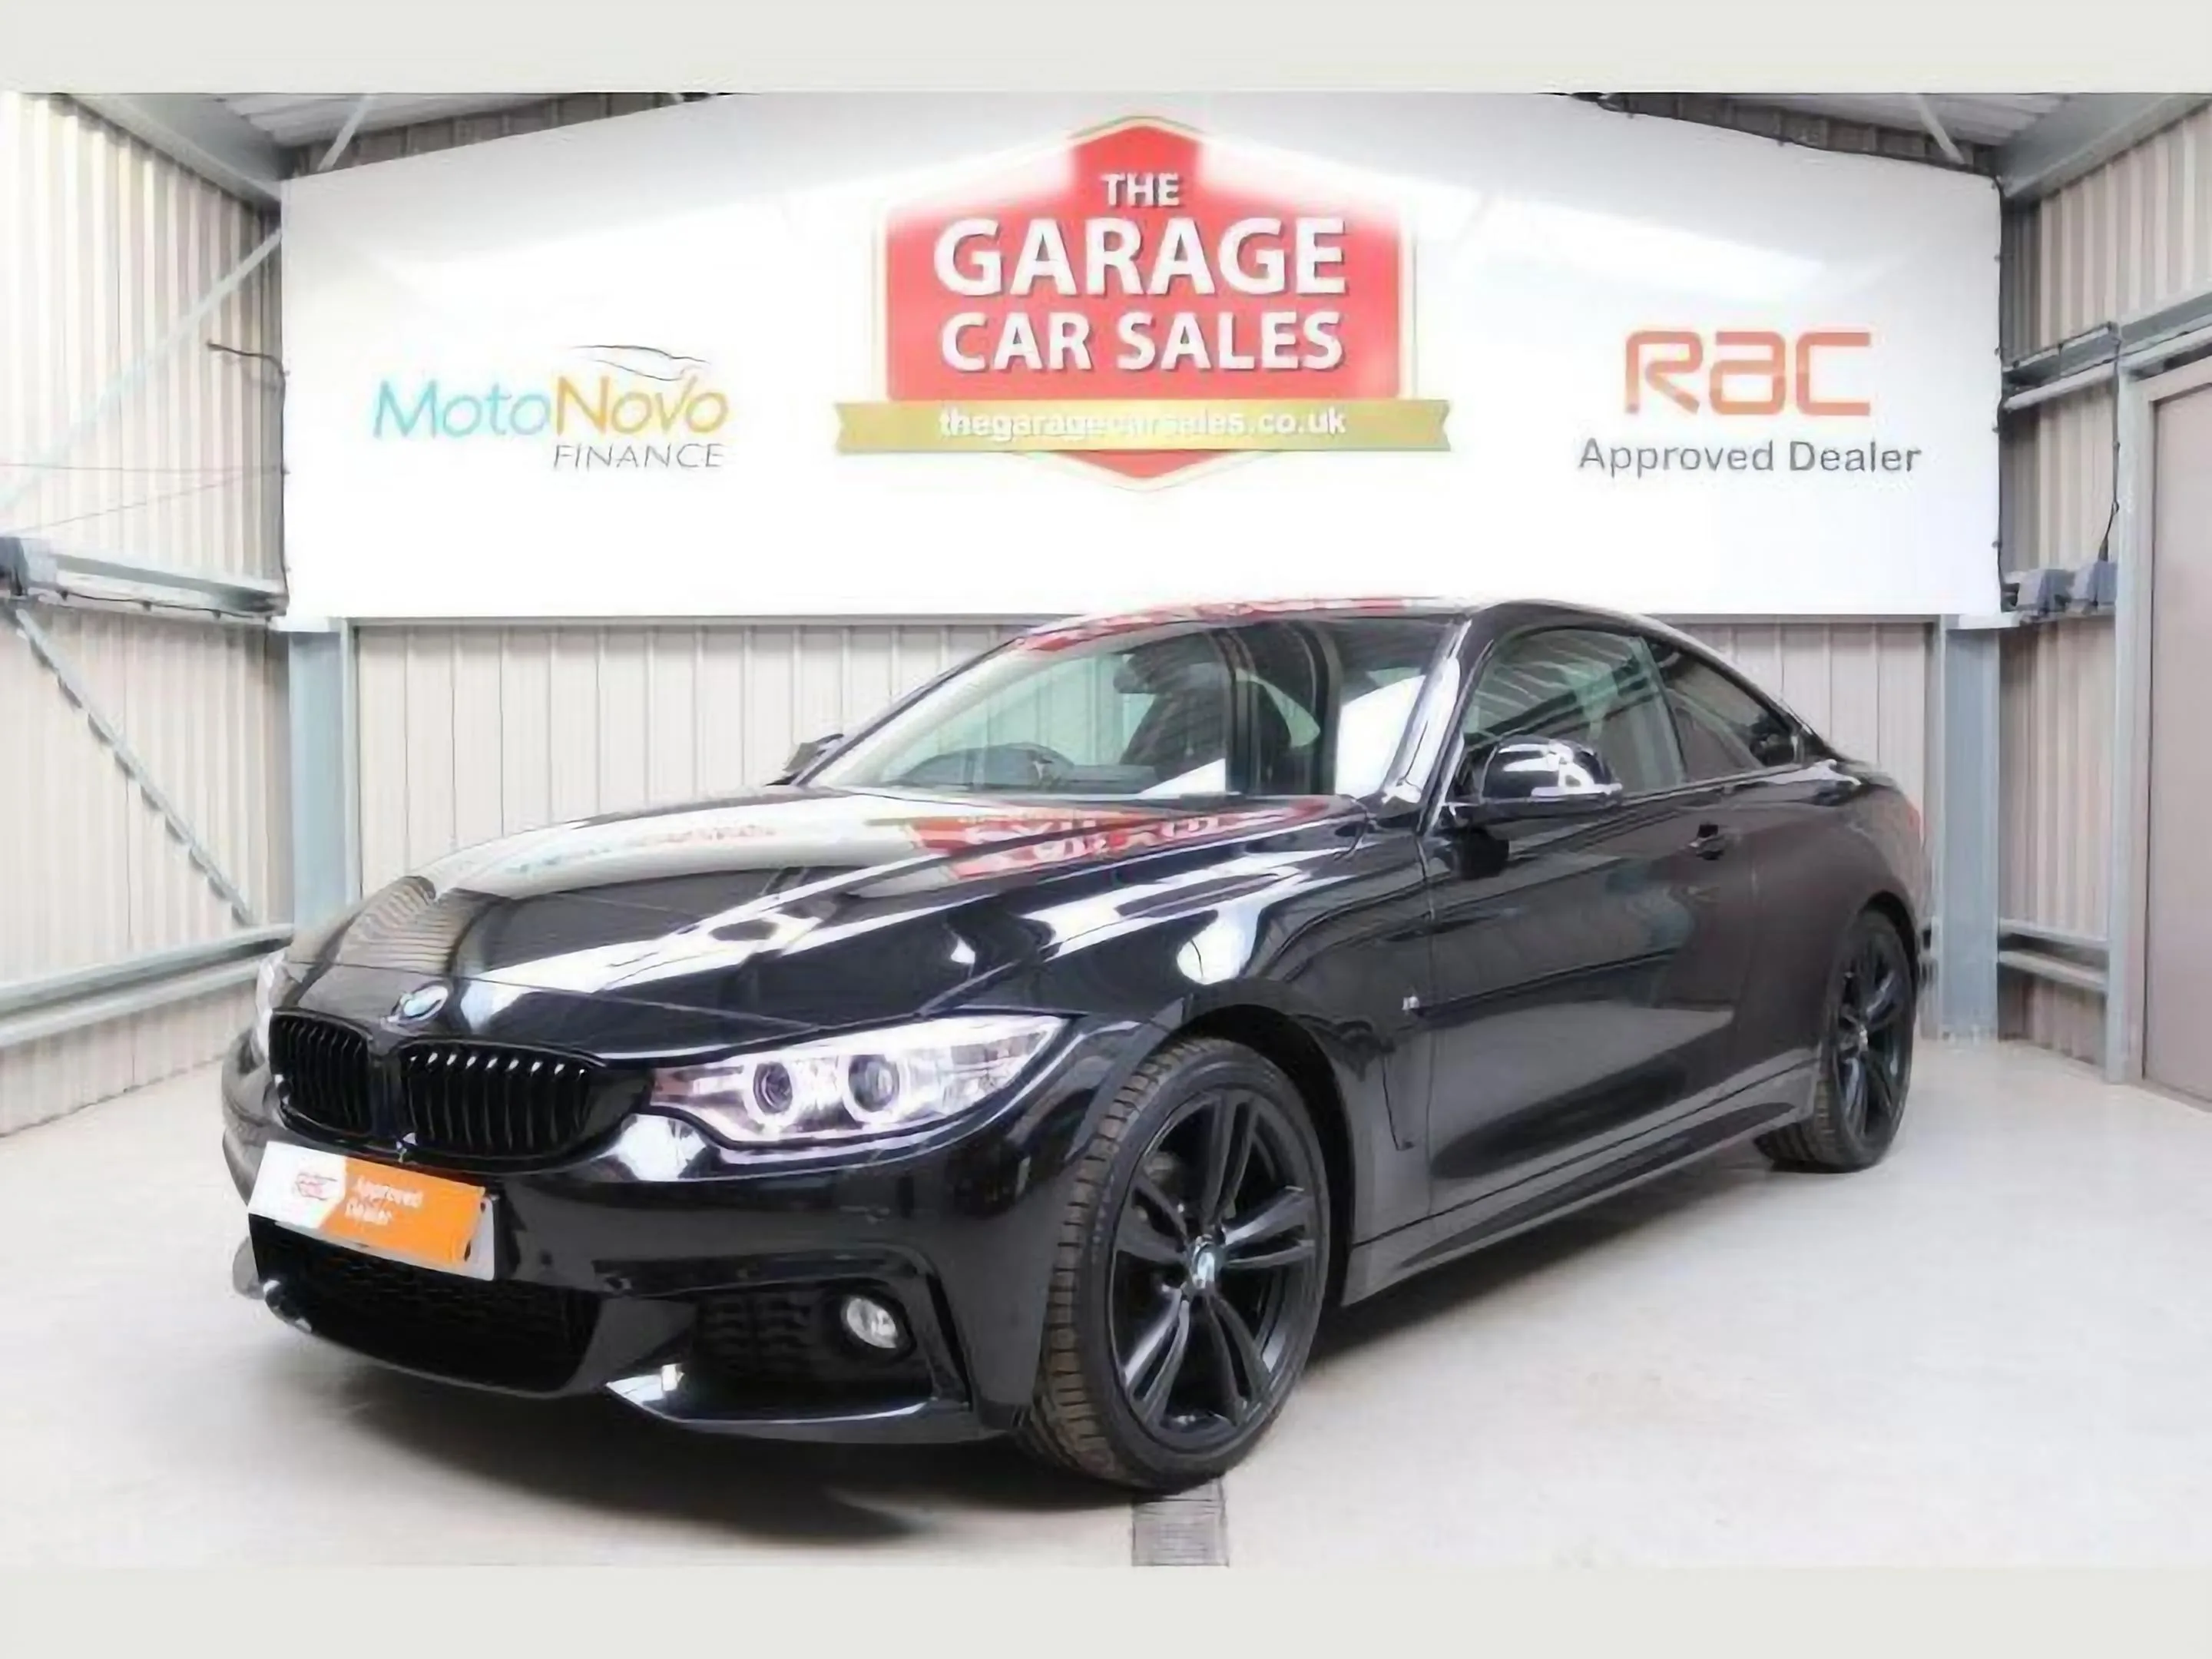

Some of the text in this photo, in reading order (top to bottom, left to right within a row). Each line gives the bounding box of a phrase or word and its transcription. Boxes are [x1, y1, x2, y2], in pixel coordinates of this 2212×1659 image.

[1101, 172, 1181, 207] THE
[933, 217, 1346, 297] GARAGE
[940, 312, 1344, 372] CAR SALES
[553, 443, 725, 469] FINANCE
[1579, 438, 1922, 478] Approved Dealer
